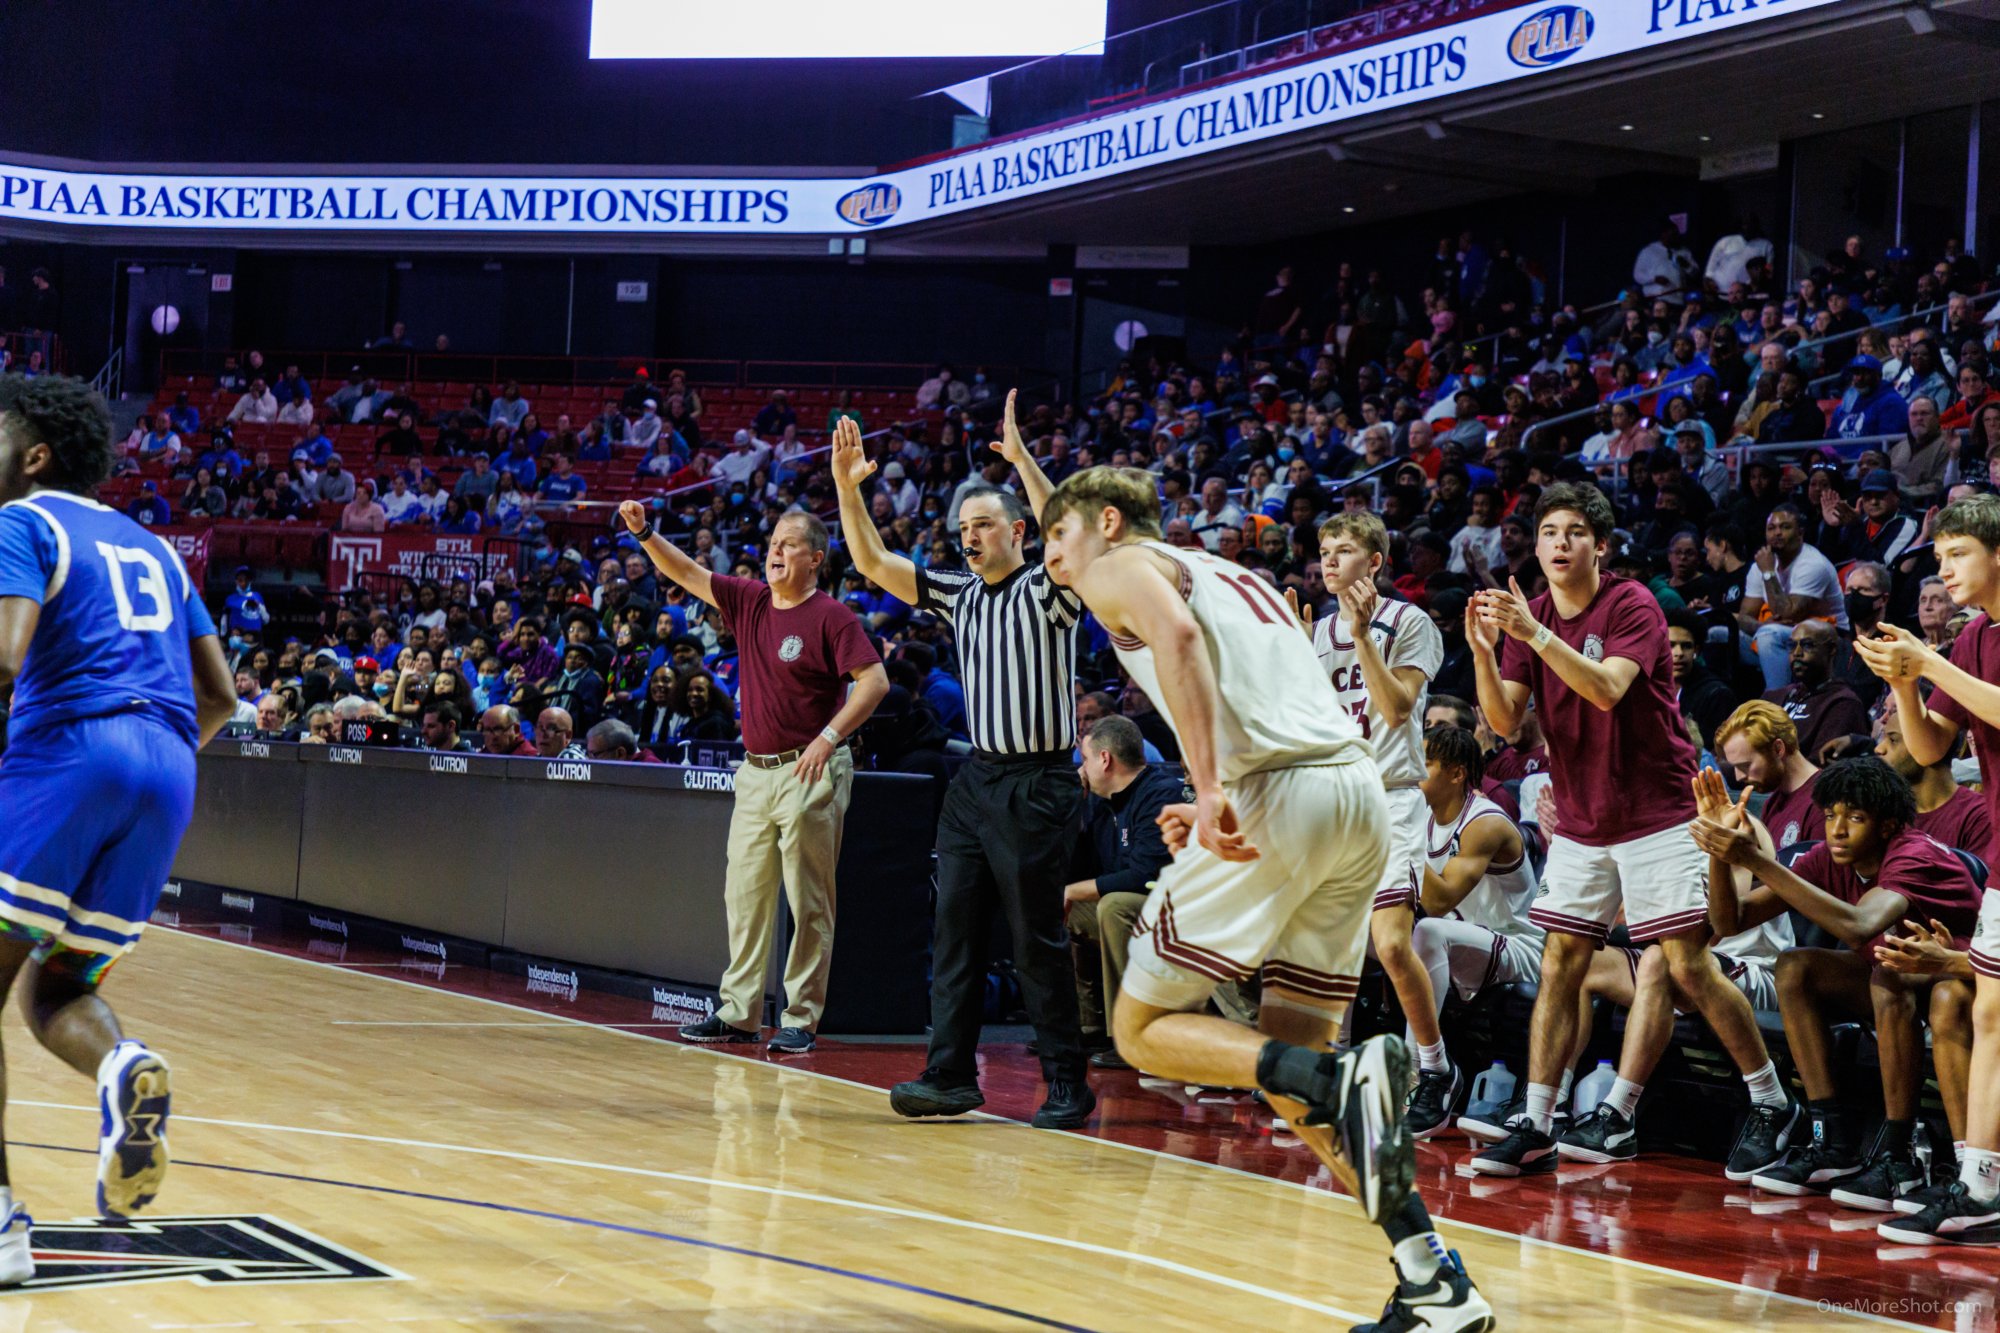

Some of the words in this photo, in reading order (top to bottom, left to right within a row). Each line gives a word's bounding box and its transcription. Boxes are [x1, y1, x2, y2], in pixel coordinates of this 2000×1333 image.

[1518, 9, 1589, 60] PIAA
[928, 162, 985, 209] PIAA
[991, 115, 1169, 193] BASKETBALL
[1175, 36, 1467, 147] CHAMPIONSHIPS
[0, 175, 110, 216] PIAA
[118, 185, 397, 221] BASKETBALL
[405, 187, 790, 224] CHAMPIONSHIPS
[848, 186, 899, 220] PIAA
[95, 540, 174, 633] 13
[1214, 571, 1297, 630] 11
[347, 723, 367, 741] POSS
[1341, 697, 1372, 740] 3
[553, 763, 591, 781] LUTRON
[528, 964, 570, 985] Independence
[653, 987, 704, 1012] Independence
